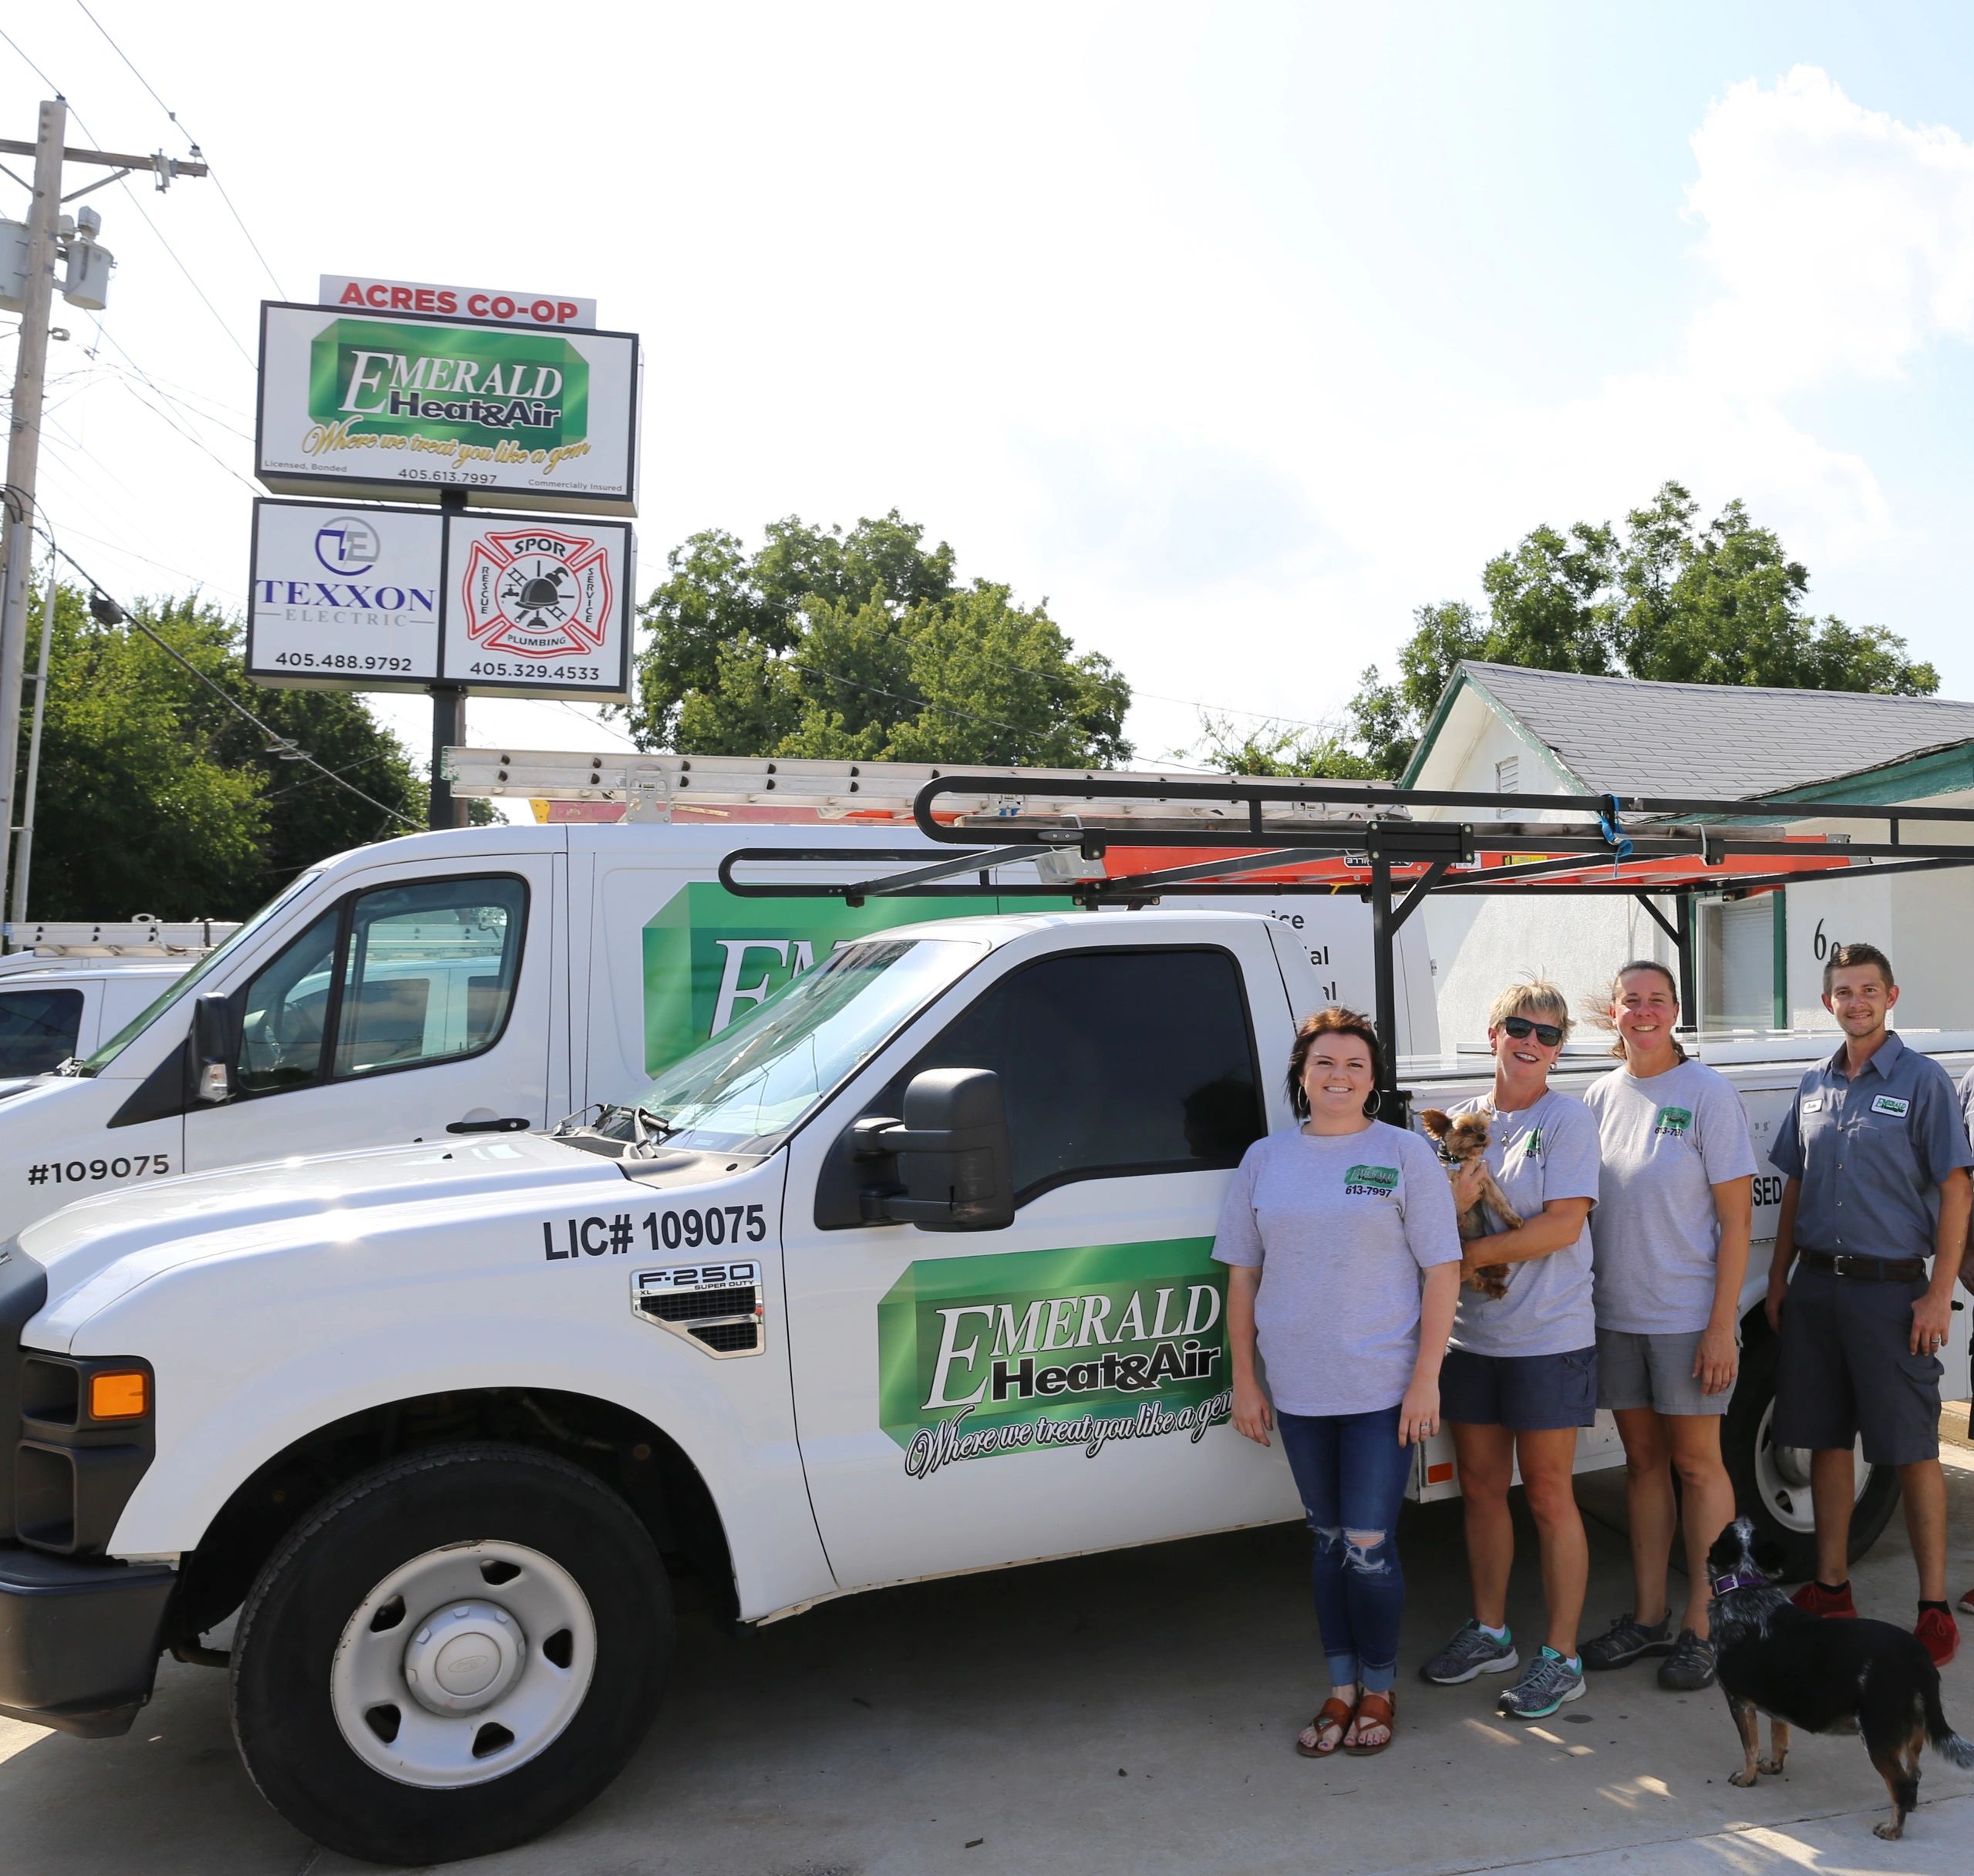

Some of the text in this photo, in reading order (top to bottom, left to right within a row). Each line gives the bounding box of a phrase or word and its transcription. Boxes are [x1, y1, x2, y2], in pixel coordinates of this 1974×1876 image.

[340, 282, 578, 324] ACRES CO-OP
[338, 350, 562, 414] EMERALD
[389, 389, 562, 430] Heat&Air
[301, 416, 591, 475] Where we treat you like a gem
[264, 460, 347, 473] Licensed, Bonded
[399, 468, 497, 484] 405.613.7997
[528, 479, 622, 492] Commercially Insured
[514, 538, 566, 557] SPOR
[256, 579, 436, 612] TEXXON
[481, 566, 490, 614] RESCUE
[585, 568, 595, 623] SERVICE
[286, 608, 408, 627] ELECTRIC
[507, 634, 566, 646] PLUMBING
[275, 652, 412, 672] 405.488.9792
[470, 662, 599, 680] 405.329.4533
[1875, 1098, 1907, 1110] EMERALD
[28, 1154, 170, 1185] #109075
[1346, 1184, 1393, 1197] 613-7997
[543, 1204, 766, 1261] LIC# 109075
[638, 1263, 754, 1288] F-250
[921, 1284, 1220, 1411] EMERALD
[990, 1339, 1221, 1403] Heat&Air
[904, 1404, 1001, 1480] Where
[999, 1421, 1032, 1448] we
[1036, 1414, 1092, 1445] treat
[1086, 1420, 1136, 1459] you
[1134, 1400, 1176, 1437] like
[1177, 1413, 1197, 1432] a
